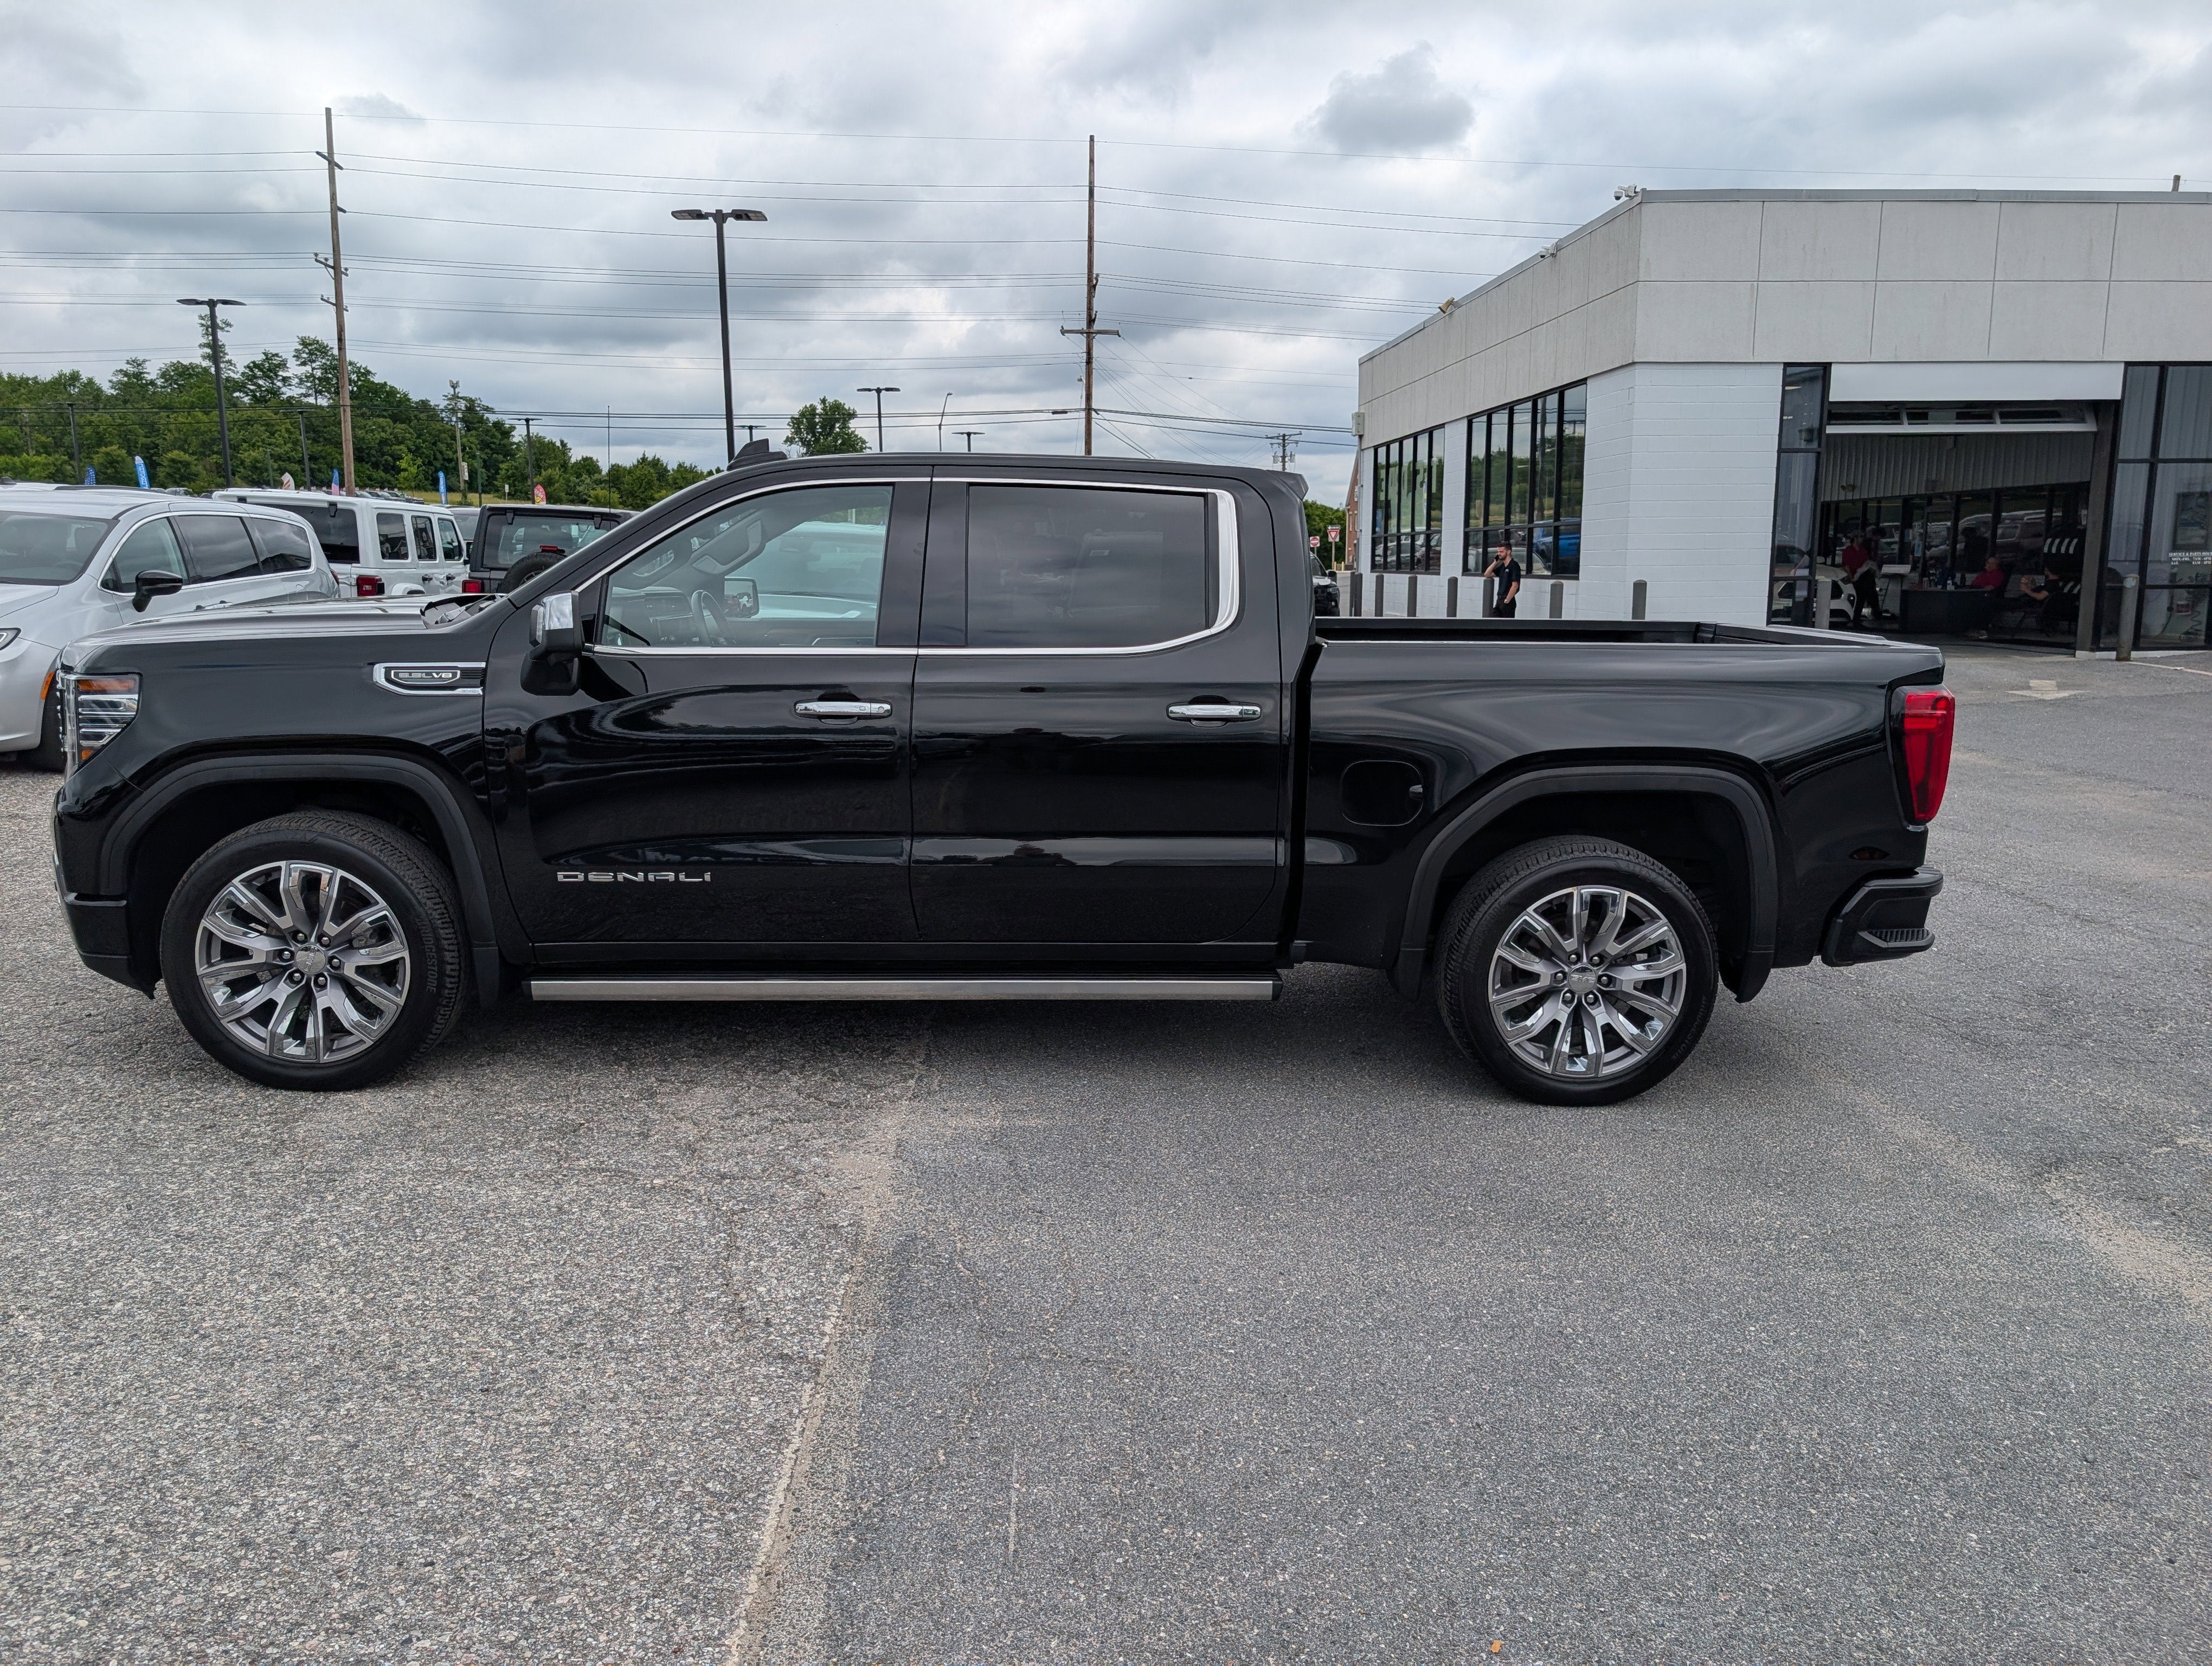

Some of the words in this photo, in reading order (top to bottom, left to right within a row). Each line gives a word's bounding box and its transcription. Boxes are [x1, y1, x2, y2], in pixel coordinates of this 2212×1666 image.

[557, 872, 711, 882] DENALI
[415, 917, 438, 993] BRIDGESTONE
[1571, 974, 1595, 983] GMC
